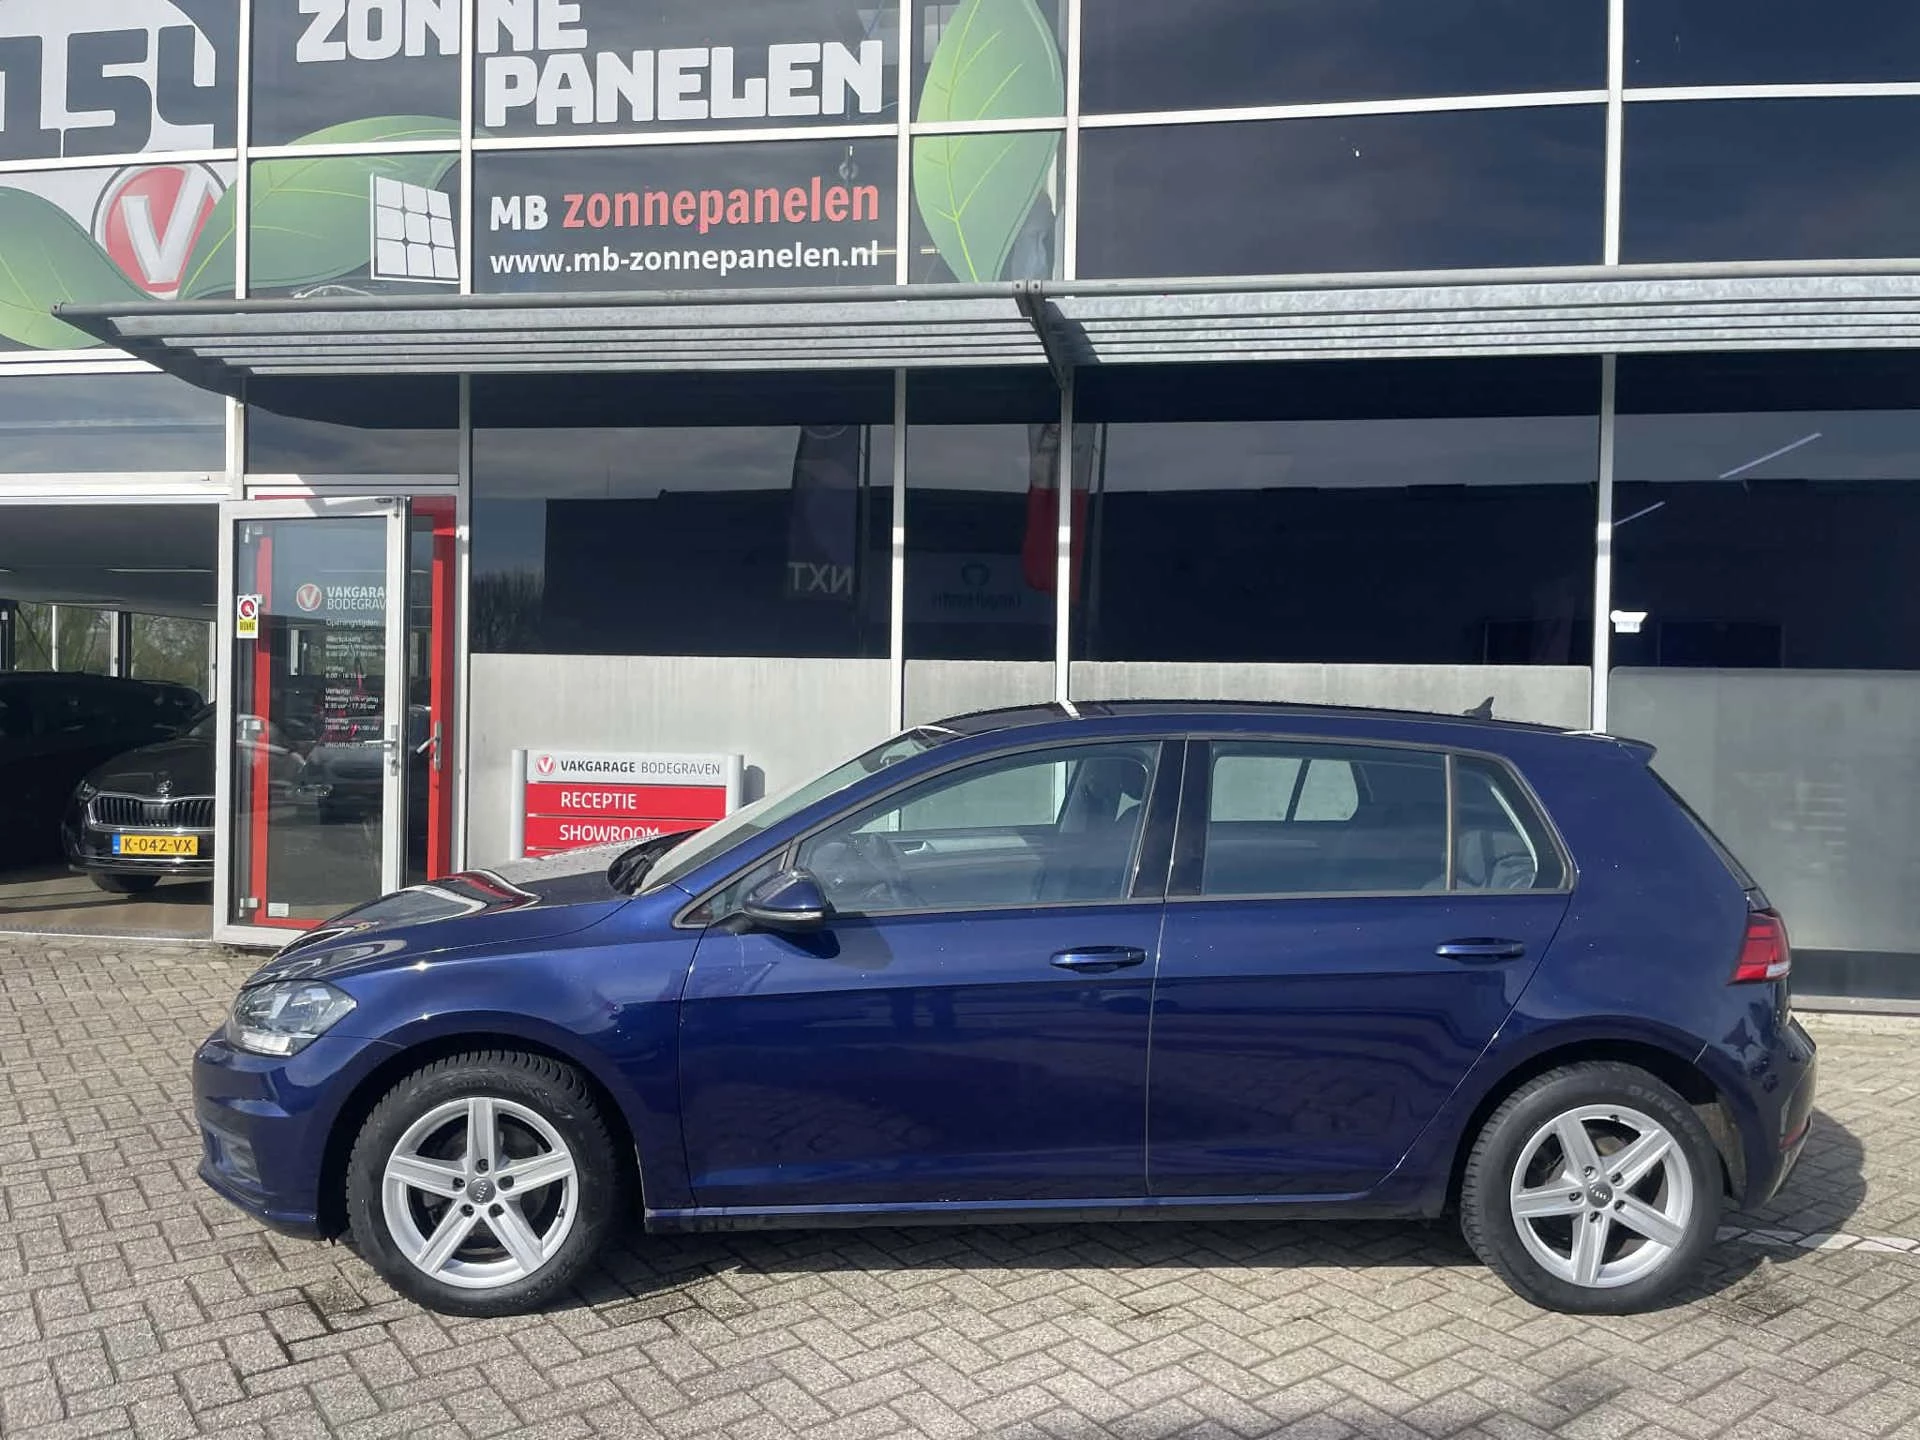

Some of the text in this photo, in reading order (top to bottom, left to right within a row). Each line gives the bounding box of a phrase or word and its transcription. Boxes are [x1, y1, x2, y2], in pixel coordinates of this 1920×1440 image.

[485, 40, 883, 127] PANELEN
[490, 177, 879, 234] MB zonnepanelen
[490, 241, 879, 276] www.mb-zonnepanelen.nl
[561, 760, 636, 773] VAKGARAGE
[641, 762, 720, 775] BODEGRAVEN
[560, 791, 637, 809] RECEPTIE
[123, 836, 193, 852] K-042-VX
